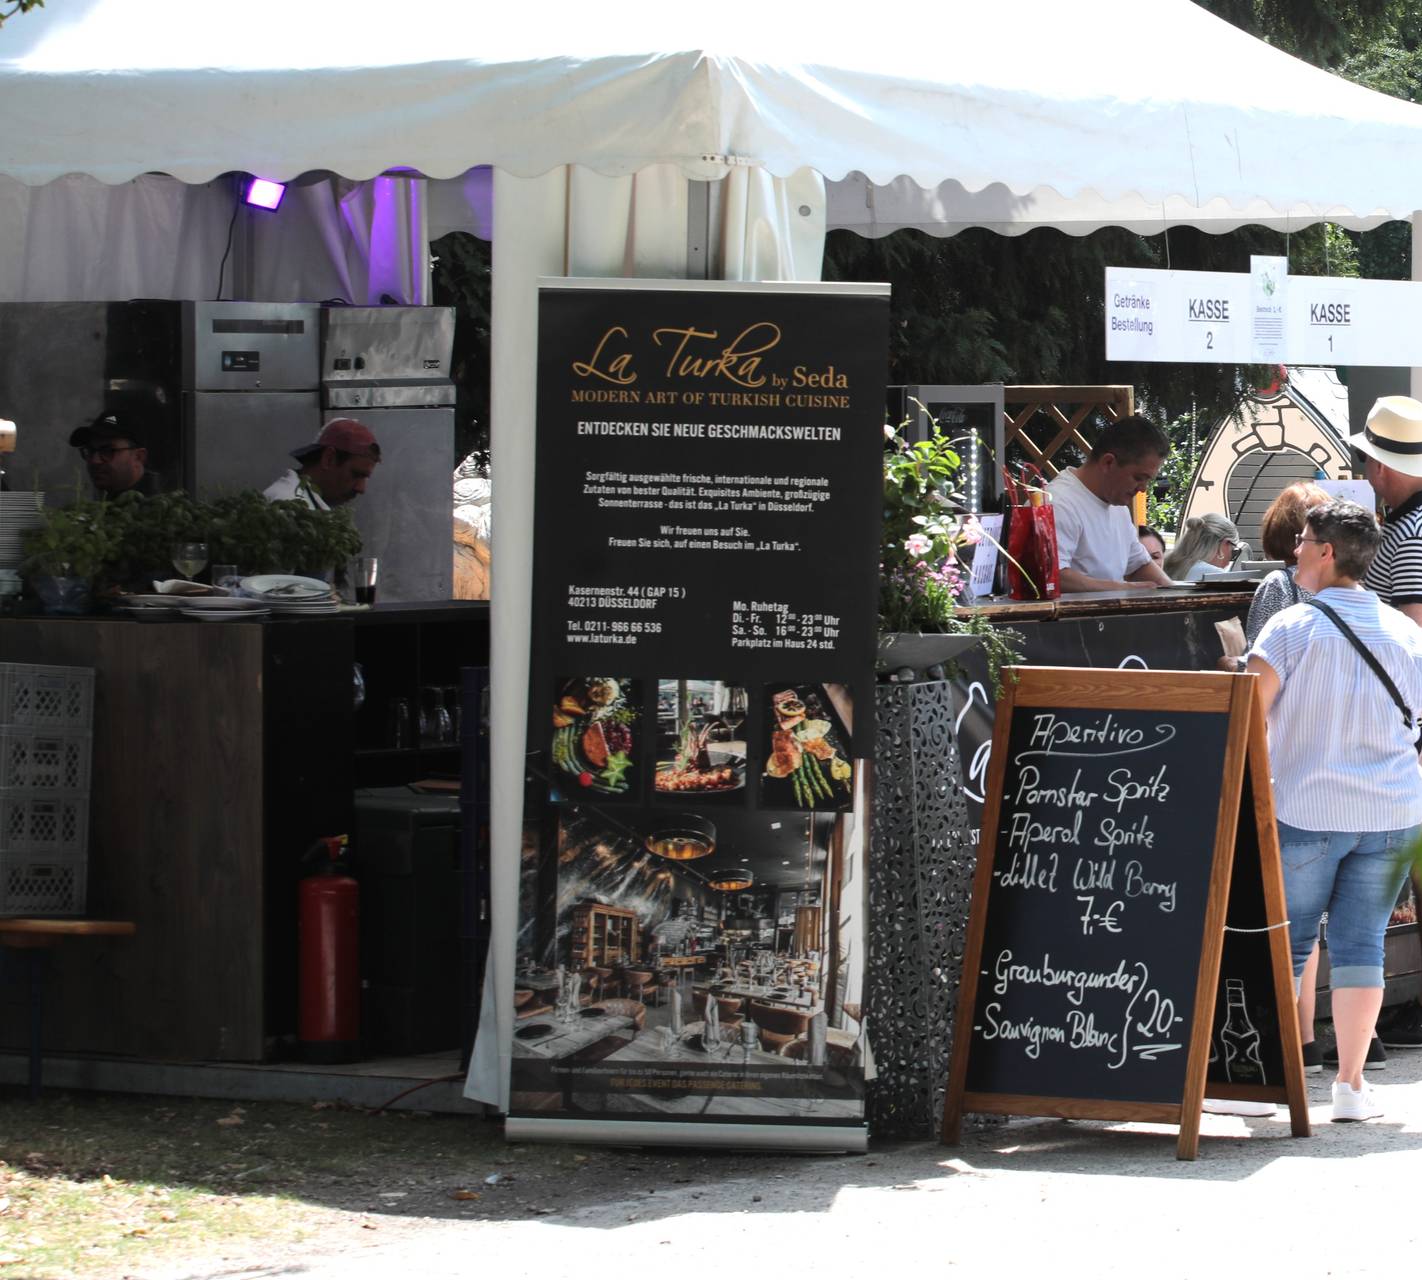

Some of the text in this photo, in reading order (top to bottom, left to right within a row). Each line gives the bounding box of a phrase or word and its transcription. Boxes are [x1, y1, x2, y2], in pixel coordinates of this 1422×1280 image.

[1114, 293, 1150, 310] Getränke
[1188, 299, 1229, 320] KASSE
[1310, 303, 1350, 323] KASSE
[1111, 317, 1153, 336] Bestellung
[1206, 331, 1214, 350] 2
[1327, 335, 1334, 352] 1
[572, 322, 848, 390] La Turka by Seda
[571, 390, 850, 408] MODERN ART OF TURKISH CUISINE
[577, 421, 841, 441] ENTDECKEN SIE NEUE GESCHMACKSWELTEN
[586, 471, 829, 488] Sorgfältig ausgewählte frische, internationale und regionale
[583, 484, 831, 501] Zutaten von bester Qualität. Exquisites Ambiente, großzügige
[598, 498, 663, 508] Sonnenterrasse
[669, 500, 684, 509] das
[685, 500, 696, 509] ist
[698, 500, 713, 510] das
[714, 501, 729, 512] „La
[758, 502, 767, 511] in
[768, 502, 814, 513] Düsseldorf.
[660, 525, 751, 537] Wir freuen uns auf Sie.
[608, 537, 637, 548] Freuen
[638, 538, 651, 548] Sie
[653, 538, 672, 549] sich,
[673, 539, 688, 549] auf
[689, 540, 711, 549] einen
[713, 540, 743, 550] Besuch
[744, 541, 755, 550] im
[756, 541, 771, 552] „La
[568, 585, 626, 597] Kasernenstr.
[627, 586, 639, 597] 44
[646, 587, 666, 597] GAP
[668, 587, 680, 598] 15
[568, 596, 658, 609] 40213 DÜSSELDORF
[733, 601, 789, 614] Mo. Ruhetag
[567, 621, 583, 631] Tel.
[611, 622, 629, 633] 966
[630, 622, 643, 633] 66
[644, 622, 662, 633] 536
[732, 613, 745, 623] Di.
[750, 613, 762, 624] Fr.
[824, 615, 840, 626] Uhr
[567, 633, 637, 645] www.laturka.de
[732, 625, 747, 635] Sa.
[753, 625, 767, 636] So.
[823, 627, 840, 638] Uhr
[731, 638, 836, 650] Parkplatz im Haus 24 std.
[1030, 714, 1144, 755] Aperitivo
[1102, 765, 1170, 813] Spritz
[1094, 816, 1155, 855] Spritz
[1073, 857, 1114, 892] Wild
[1066, 1010, 1118, 1053] Blanc
